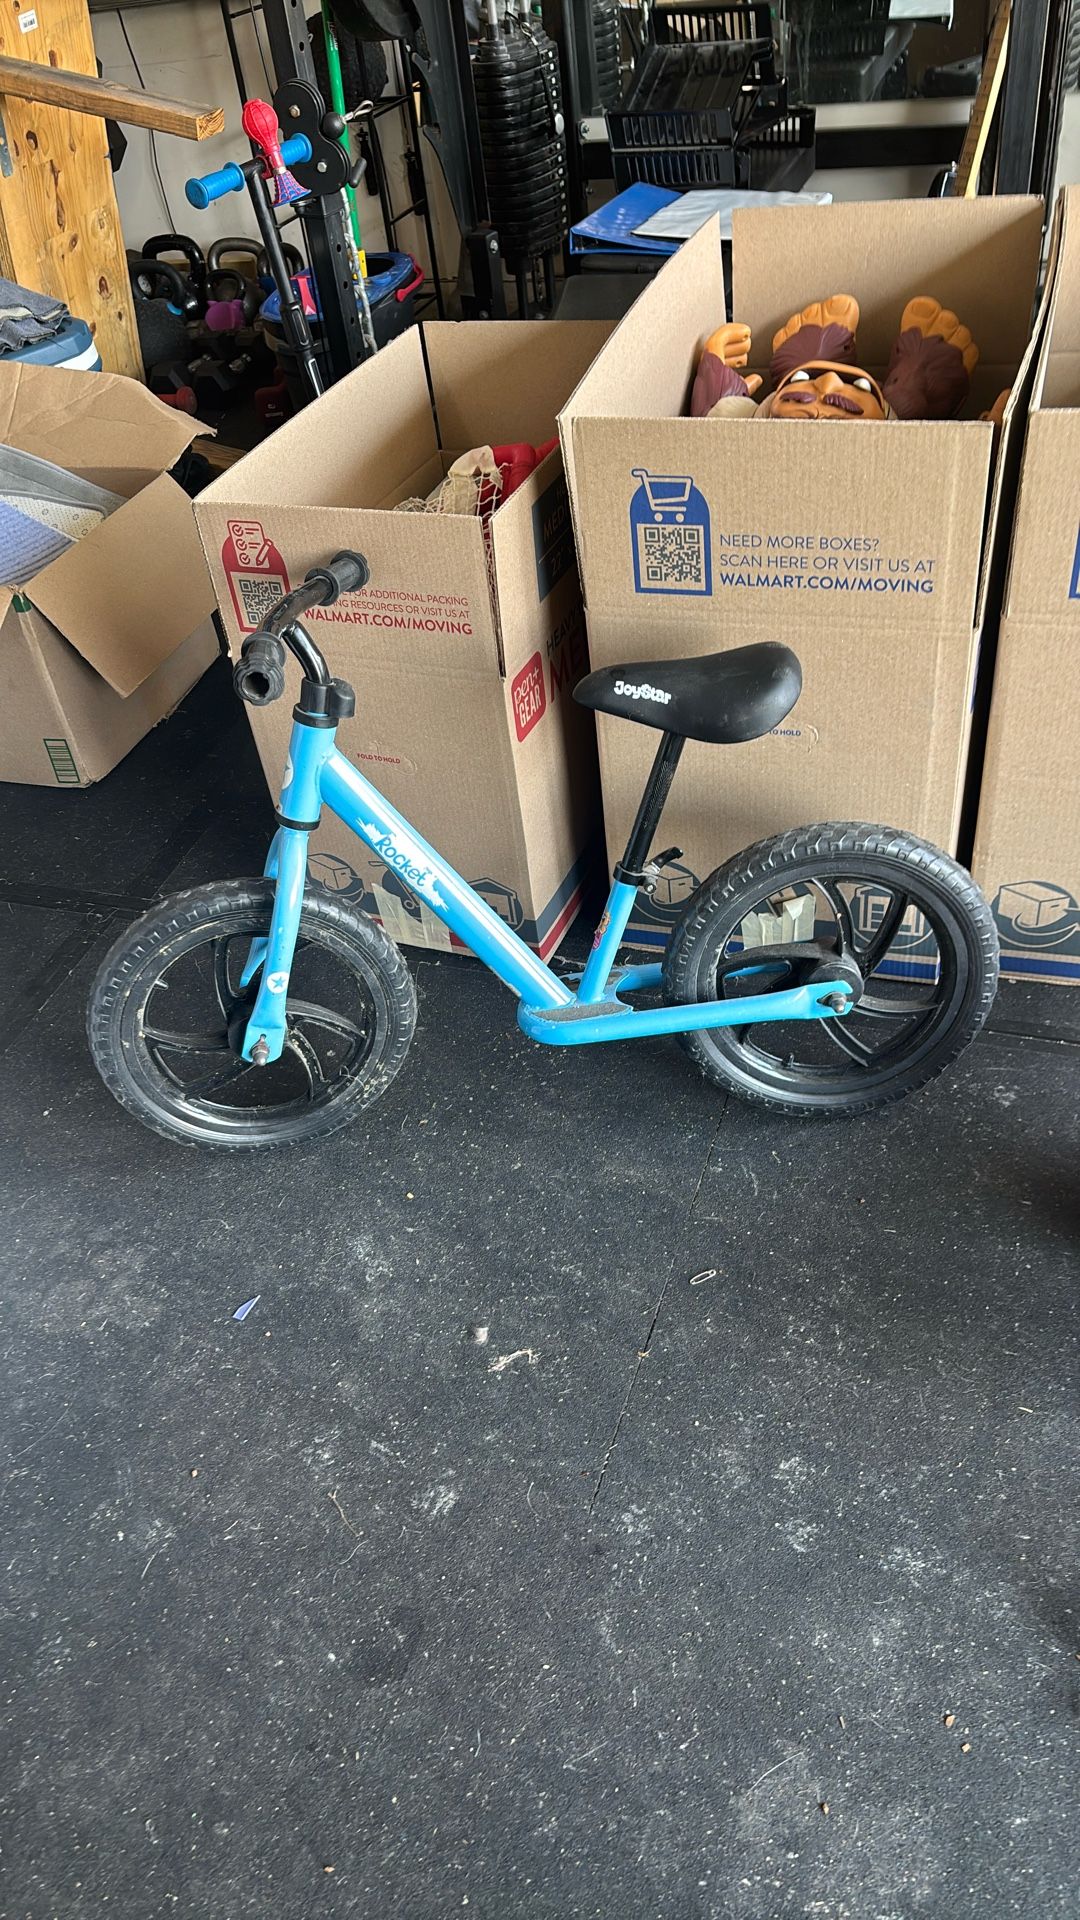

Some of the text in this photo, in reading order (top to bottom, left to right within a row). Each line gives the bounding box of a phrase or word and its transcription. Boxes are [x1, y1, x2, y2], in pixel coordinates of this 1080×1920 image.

[719, 534, 880, 552] NEED MORE BOXES?
[719, 554, 936, 574] SCAN HERE OR VISIT US AT
[719, 572, 934, 594] WALMART.COM/MOVING
[369, 590, 426, 604] ADDITIONAL
[427, 594, 469, 607] PACKING
[351, 600, 404, 613] RESOURCES
[405, 604, 420, 615] OR
[420, 606, 443, 618] VISIT
[444, 609, 458, 618] US
[458, 610, 470, 619] AT
[304, 608, 473, 635] WALMART.COM/MOVING
[613, 680, 672, 705] JoyStar
[519, 684, 542, 728] GEAR
[779, 729, 802, 737] HOLD
[357, 752, 401, 764] FOLD TO HOLD
[374, 836, 431, 887] Rocket
